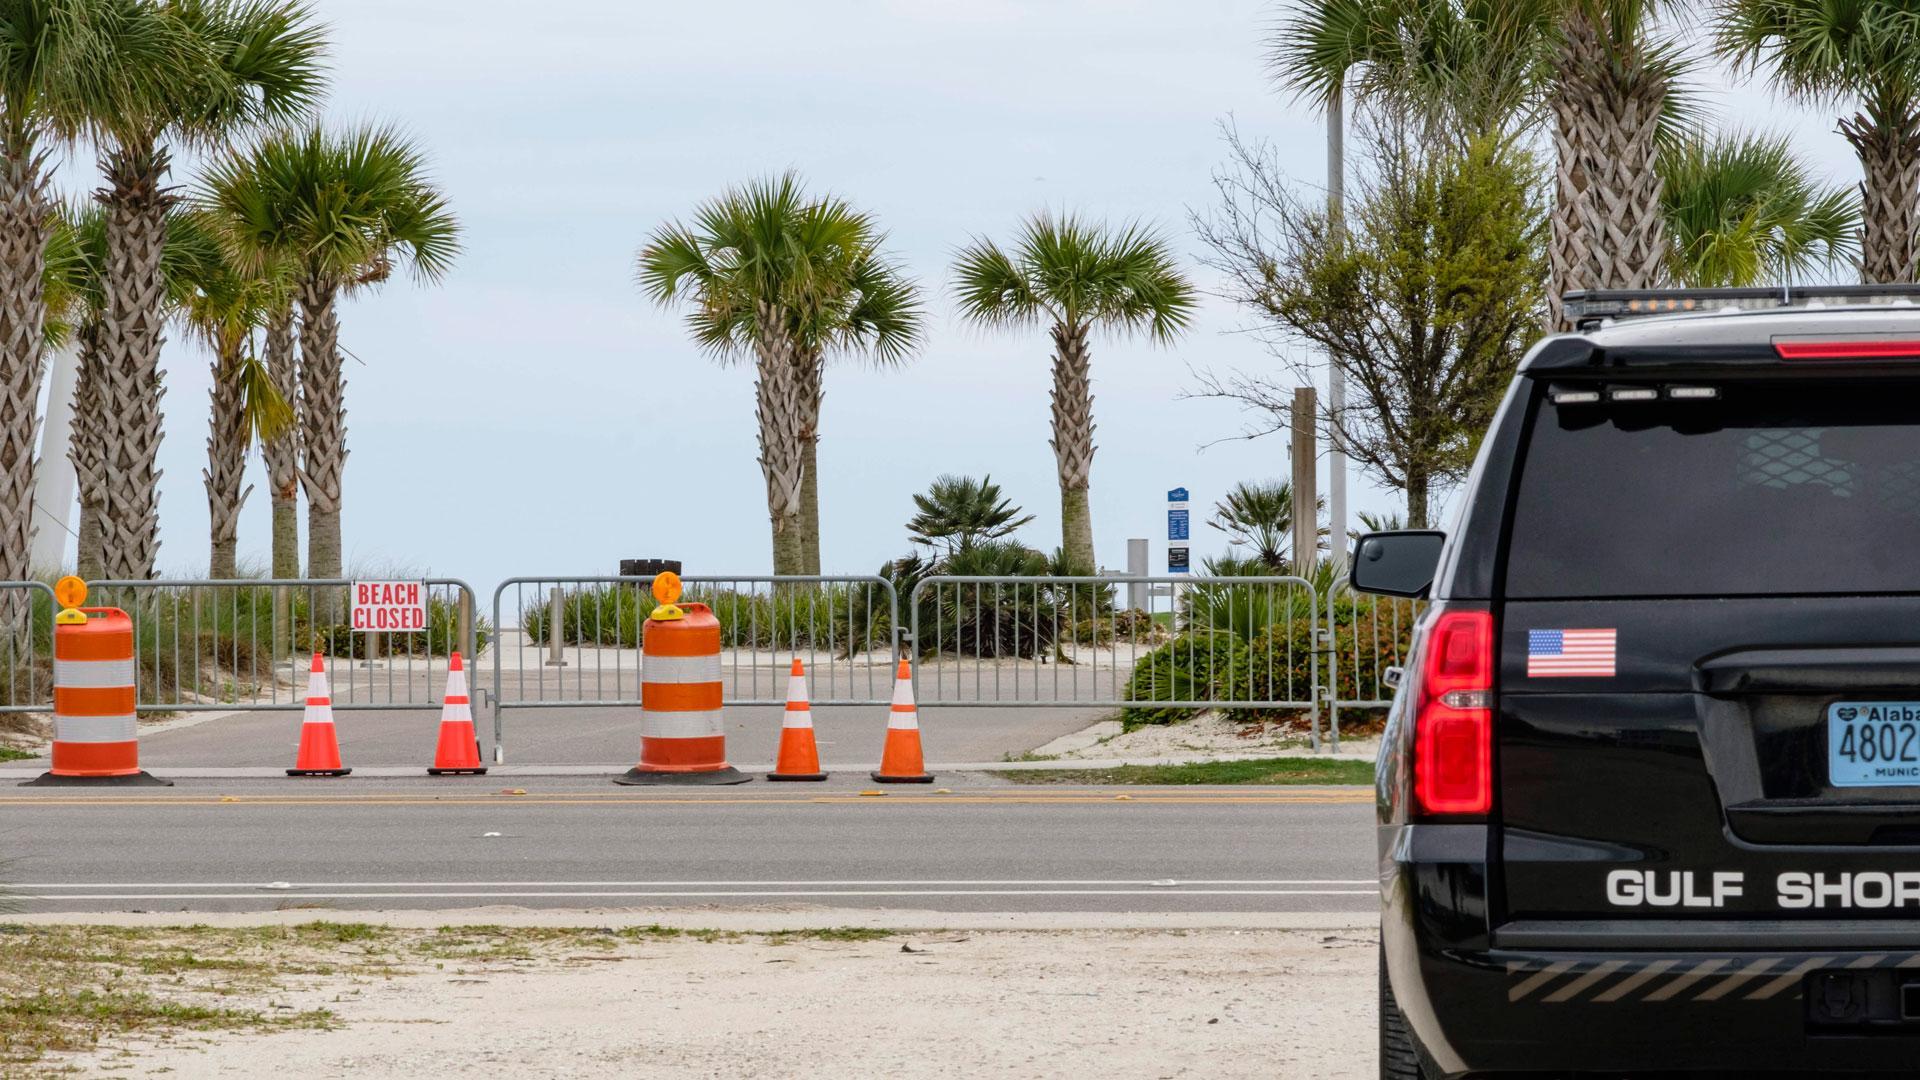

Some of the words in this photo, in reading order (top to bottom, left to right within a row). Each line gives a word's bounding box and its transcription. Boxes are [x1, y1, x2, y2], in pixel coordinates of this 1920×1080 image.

[358, 583, 418, 605] BEACH
[353, 607, 423, 629] CLOSED
[1839, 723, 1917, 763] 4802
[1875, 767, 1920, 777] MUNIC
[1606, 869, 1744, 907] GULF
[1777, 871, 1920, 909] SHOR
